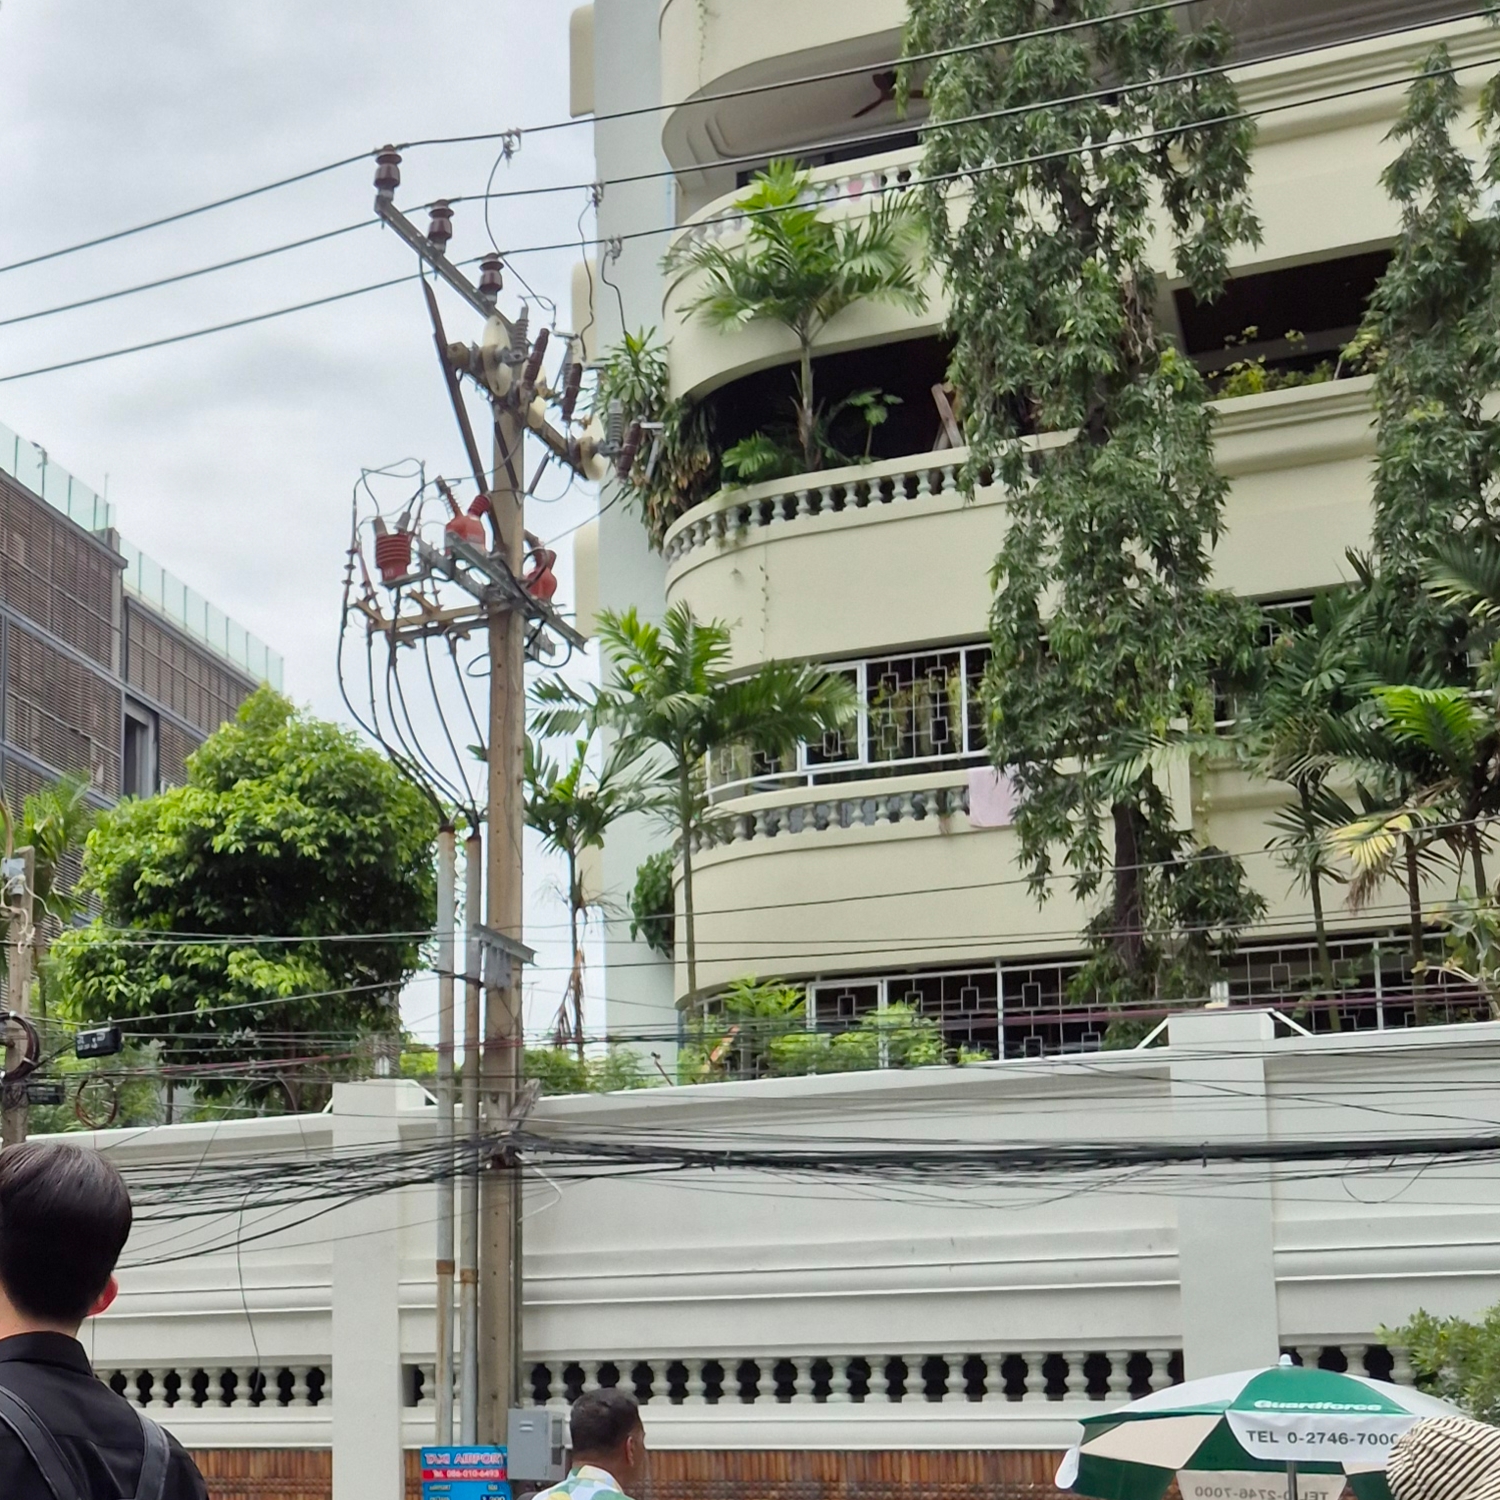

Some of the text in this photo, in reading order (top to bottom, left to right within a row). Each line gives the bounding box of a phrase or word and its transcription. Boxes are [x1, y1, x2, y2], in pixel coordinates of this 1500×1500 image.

[1254, 1399, 1382, 1411] Guardforce
[1246, 1430, 1279, 1443] TEL
[425, 1453, 450, 1465] TAXI
